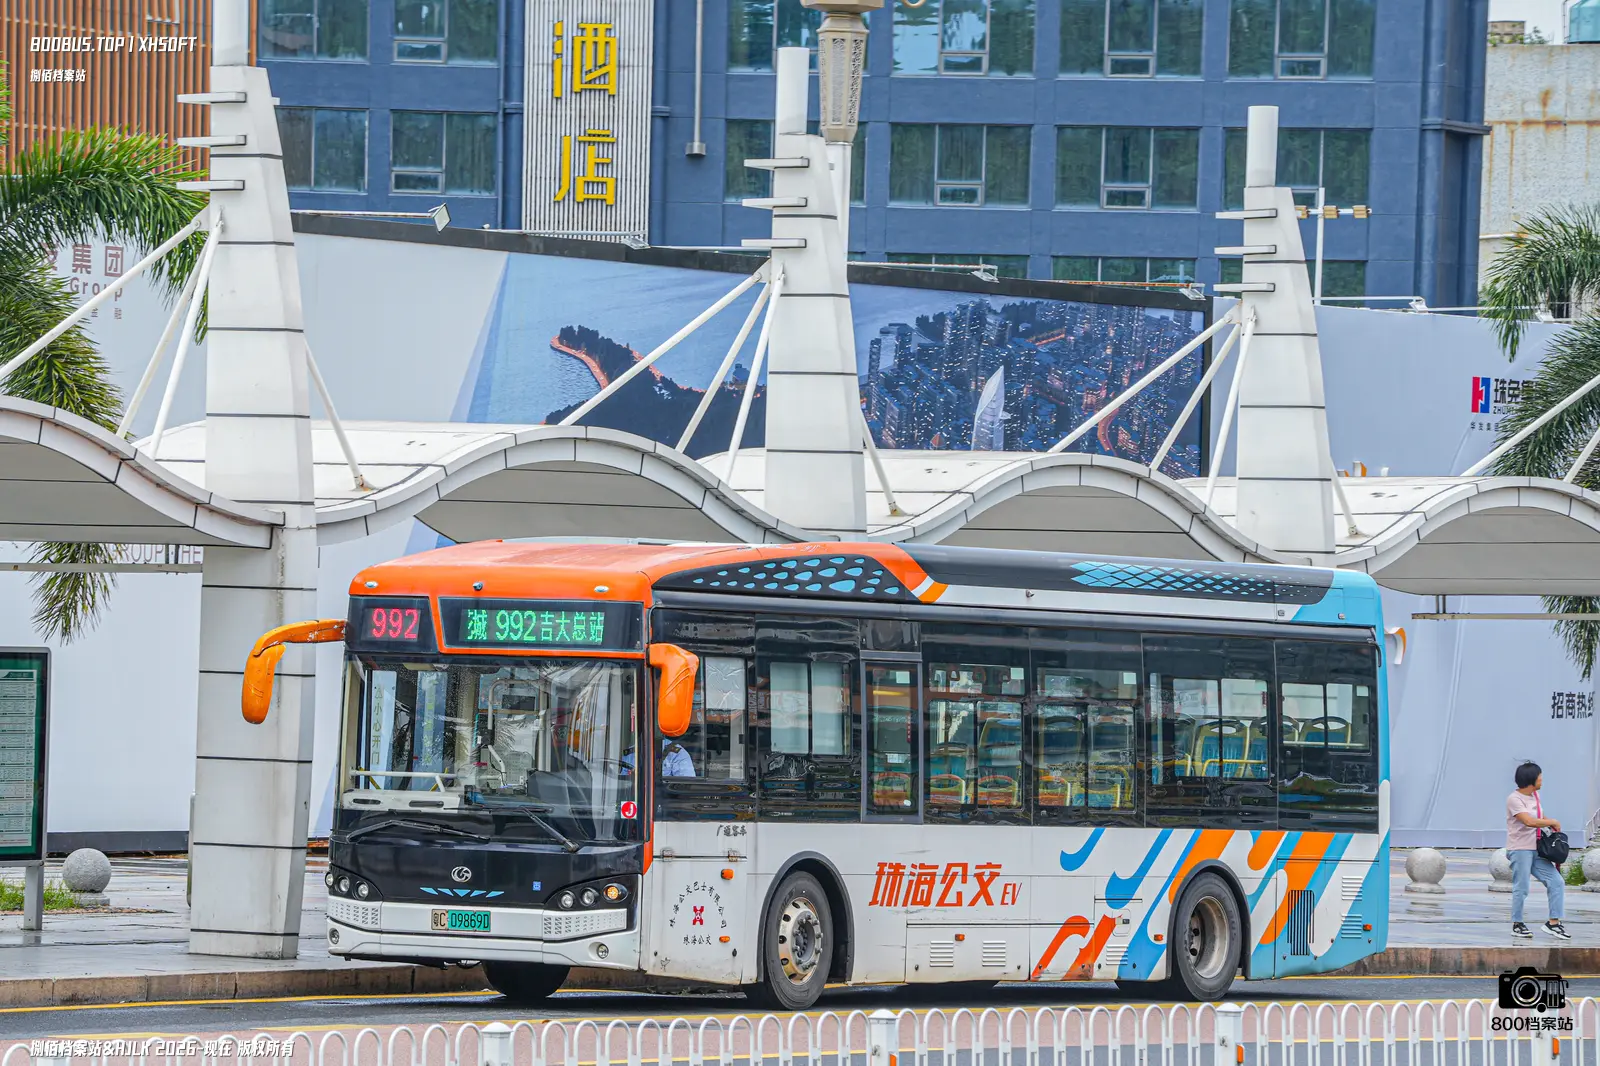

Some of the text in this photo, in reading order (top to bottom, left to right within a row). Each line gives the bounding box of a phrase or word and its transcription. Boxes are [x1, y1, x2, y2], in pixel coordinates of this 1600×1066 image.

[553, 21, 617, 205] 酒店
[372, 608, 419, 639] 992
[868, 862, 1023, 907] 珠海公交 EV
